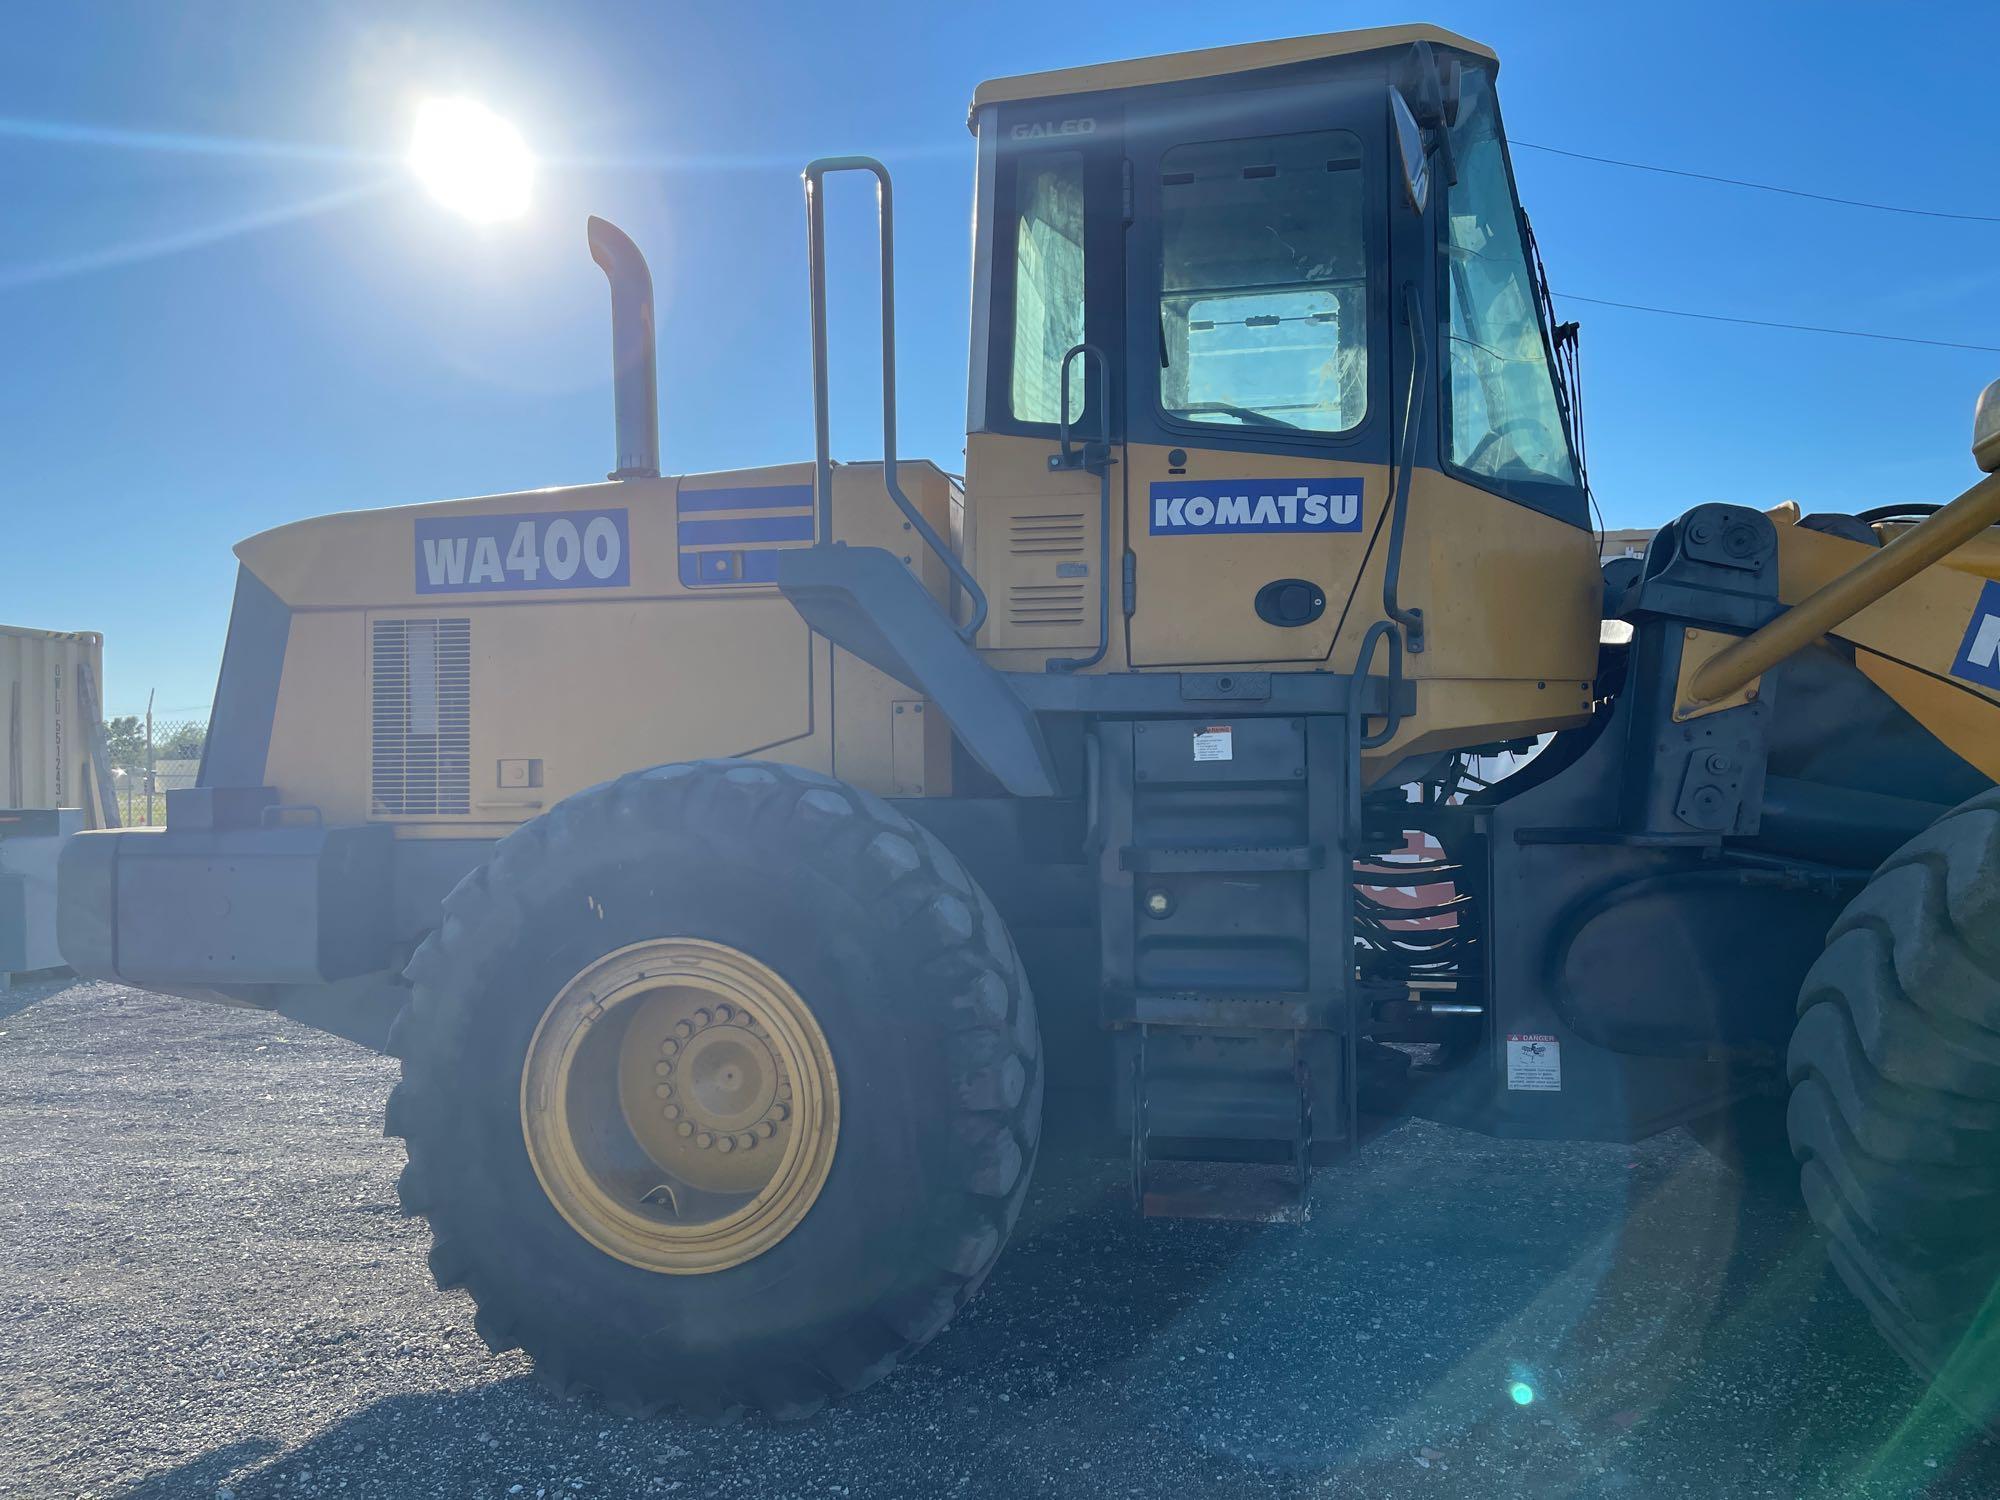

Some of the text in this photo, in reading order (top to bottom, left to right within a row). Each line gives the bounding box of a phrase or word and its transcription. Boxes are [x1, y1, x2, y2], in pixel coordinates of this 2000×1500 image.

[1010, 118, 1097, 141] GALEO
[1154, 486, 1359, 527] KOMATSU
[422, 516, 621, 586] WA400
[1523, 1034, 1556, 1042] DANGER
